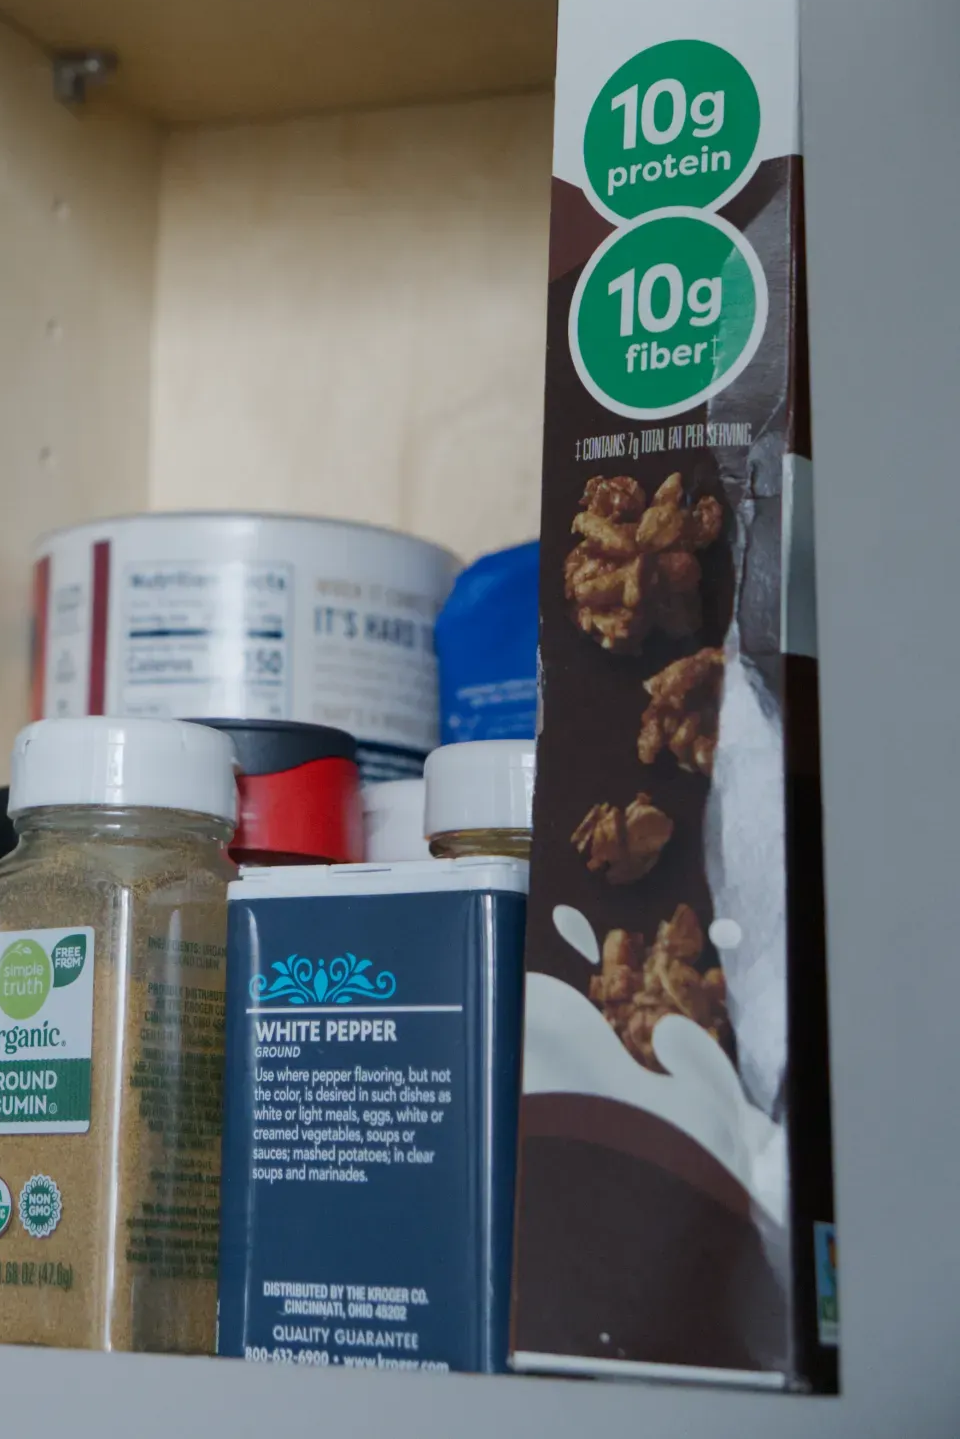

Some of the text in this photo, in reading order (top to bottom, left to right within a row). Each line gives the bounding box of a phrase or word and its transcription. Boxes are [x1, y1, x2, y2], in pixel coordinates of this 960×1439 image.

[611, 78, 725, 150] 10g
[607, 146, 732, 196] protein
[607, 263, 723, 337] 10g
[582, 432, 626, 461] CONTAINS
[628, 432, 639, 460] 7g
[641, 428, 665, 454] TOTAL
[668, 425, 683, 451] FAT
[685, 424, 704, 449] PER
[314, 605, 359, 639] IT'S
[55, 946, 81, 958] FREE
[55, 956, 81, 969] FROM
[3, 963, 44, 980] simple
[3, 978, 44, 996] truth
[255, 1019, 397, 1042] WHITE PEPPER
[255, 1046, 301, 1058] GROUND
[255, 1066, 452, 1088] Use where pepper flavoring, but not
[254, 1086, 452, 1104] the color, is desired in such dishes as
[254, 1105, 445, 1127] white or light meals, eggs, white or
[253, 1125, 416, 1147] creamed vegetables, soups or
[252, 1145, 436, 1165] sauces; mashed potatoes; in clear
[252, 1164, 369, 1184] soups and marinades.
[28, 1193, 51, 1204] NON
[28, 1204, 51, 1216] GMO
[21, 1261, 36, 1285] OZ
[263, 1281, 429, 1305] DISTRIBUTED BY THE KROGER CO.
[284, 1300, 408, 1322] CINCINNATI, OHIO 45202
[272, 1325, 419, 1350] QUALITY GUARANTEE
[244, 1346, 330, 1366] 800-632-6900
